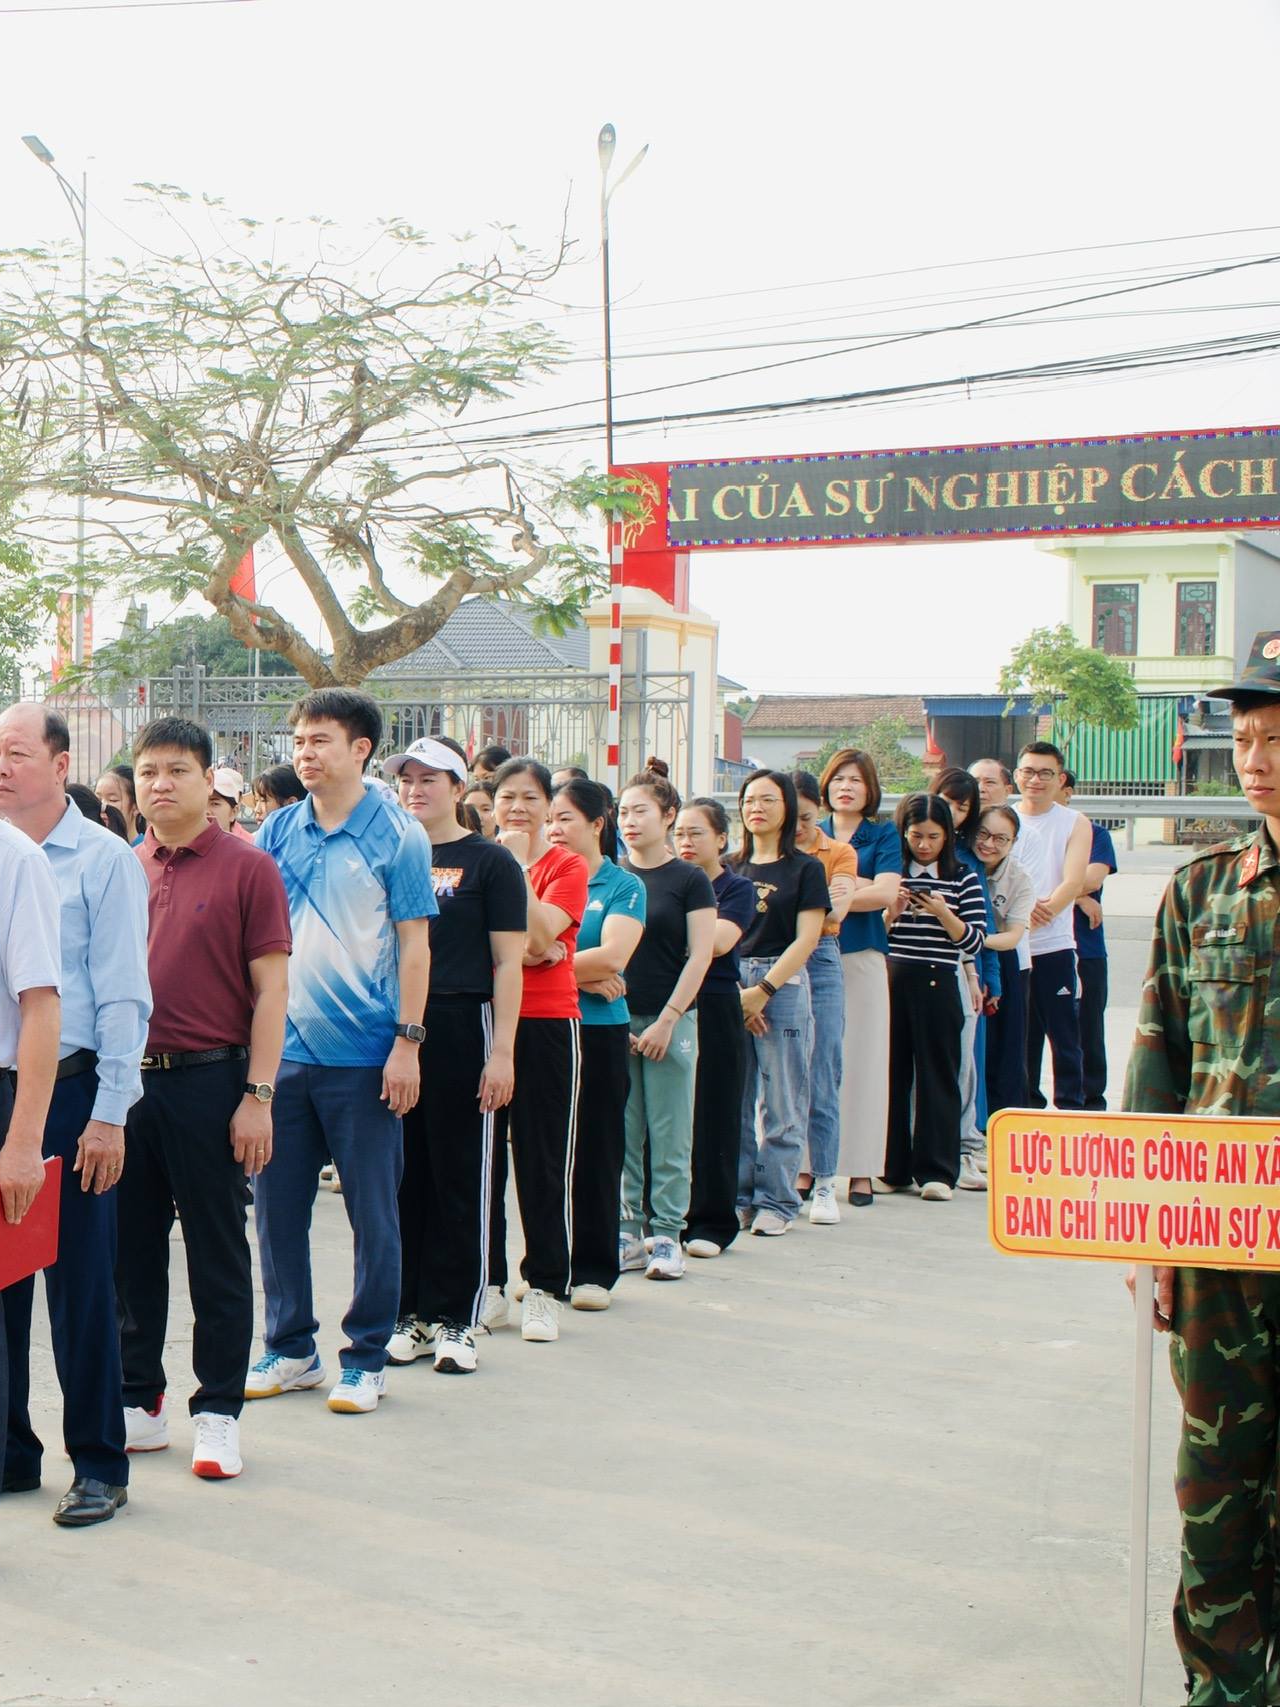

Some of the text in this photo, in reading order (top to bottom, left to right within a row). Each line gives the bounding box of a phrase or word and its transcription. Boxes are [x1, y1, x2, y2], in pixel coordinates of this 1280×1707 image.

[712, 473, 815, 521] CỦA
[825, 472, 895, 524] SỰ
[904, 462, 1109, 515] NGHIỆP
[1120, 450, 1279, 502] CÁCH
[1010, 1131, 1052, 1183] LỰC
[1060, 1133, 1135, 1182] LƯỢNG
[1144, 1131, 1208, 1182] CÔNG
[1215, 1143, 1247, 1185] AN
[1005, 1196, 1052, 1238] BAN
[1060, 1180, 1098, 1241] CHỈ
[1105, 1201, 1150, 1244] HUY
[1158, 1196, 1220, 1250] QUÂN
[1228, 1204, 1262, 1260] SỰ
